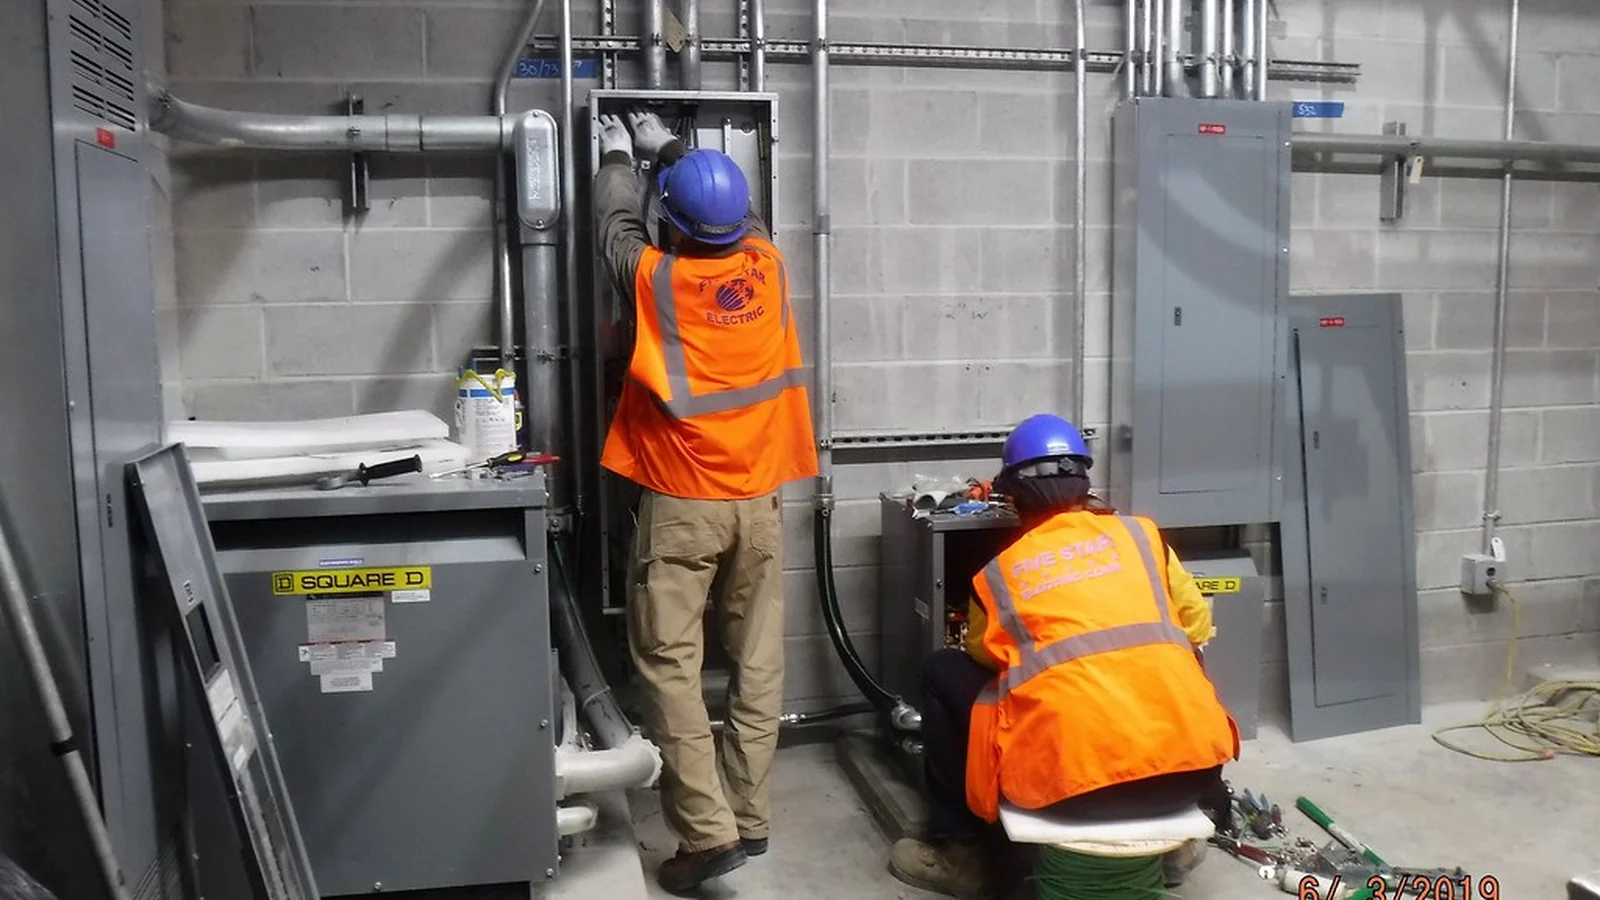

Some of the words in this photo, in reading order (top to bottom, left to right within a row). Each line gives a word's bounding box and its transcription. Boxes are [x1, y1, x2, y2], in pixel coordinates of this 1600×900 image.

[706, 306, 765, 325] ELECTRIC
[1013, 552, 1057, 577] FIVE
[1061, 535, 1114, 560] STAR
[301, 572, 395, 590] SQUARE
[405, 571, 424, 585] D
[1225, 580, 1236, 590] D
